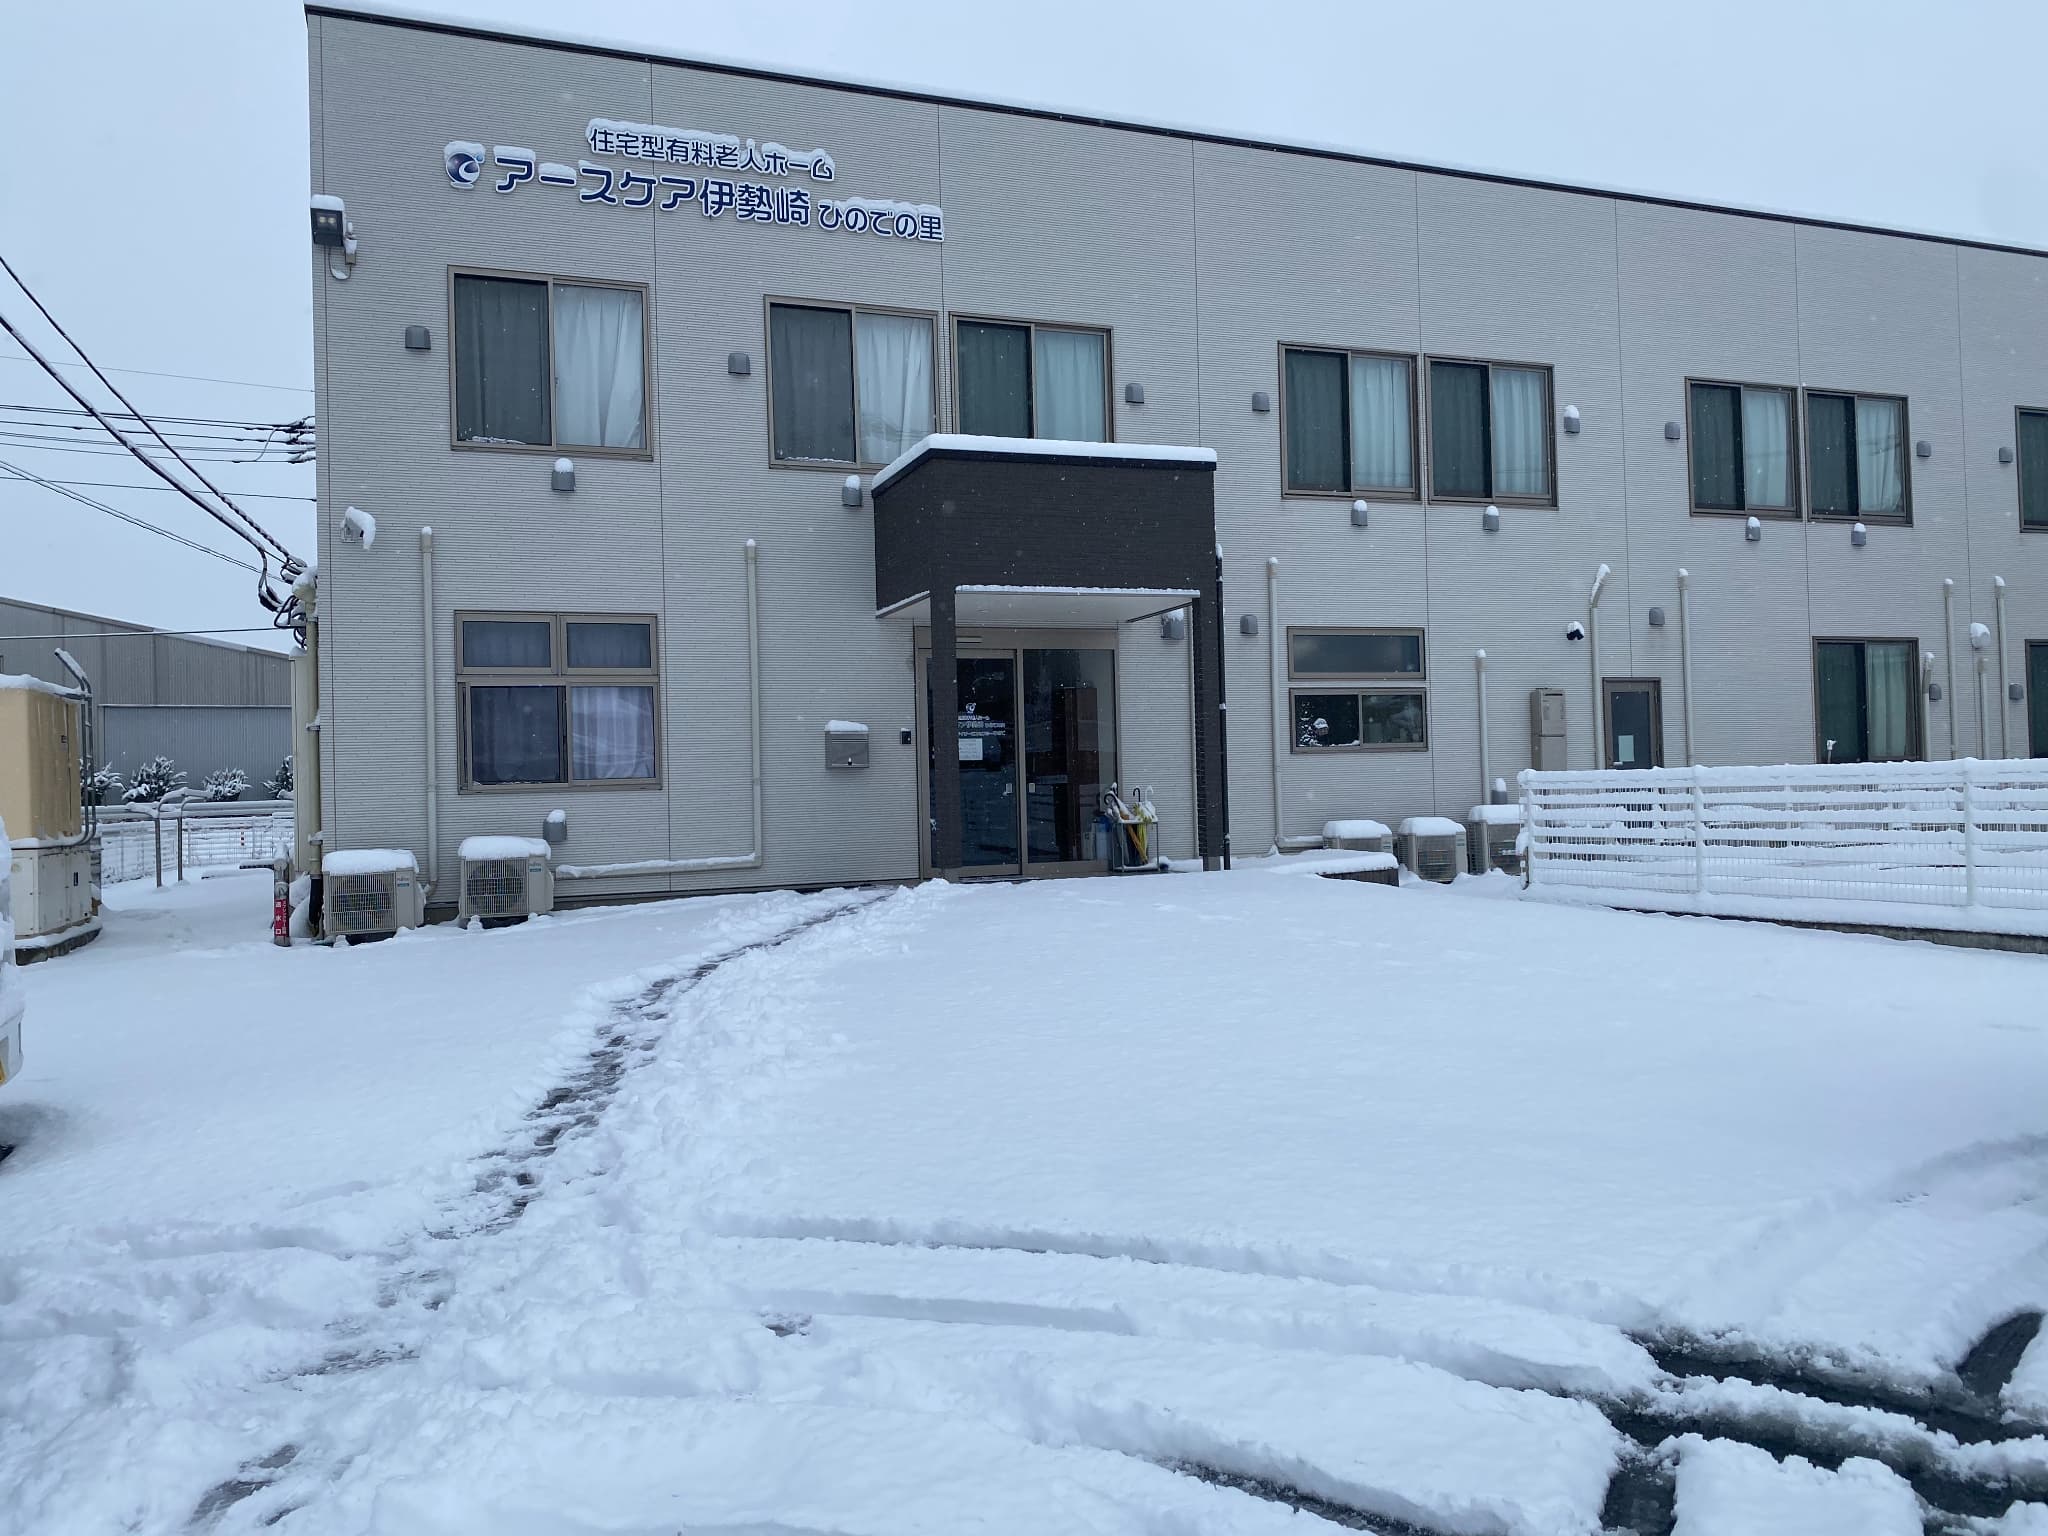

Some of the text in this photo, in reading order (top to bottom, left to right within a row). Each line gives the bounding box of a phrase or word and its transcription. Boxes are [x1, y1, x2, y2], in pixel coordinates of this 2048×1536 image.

[590, 127, 833, 180] 住宅型有料老人ホーム
[495, 157, 944, 241] アースケア伊勢崎 ひのでの里
